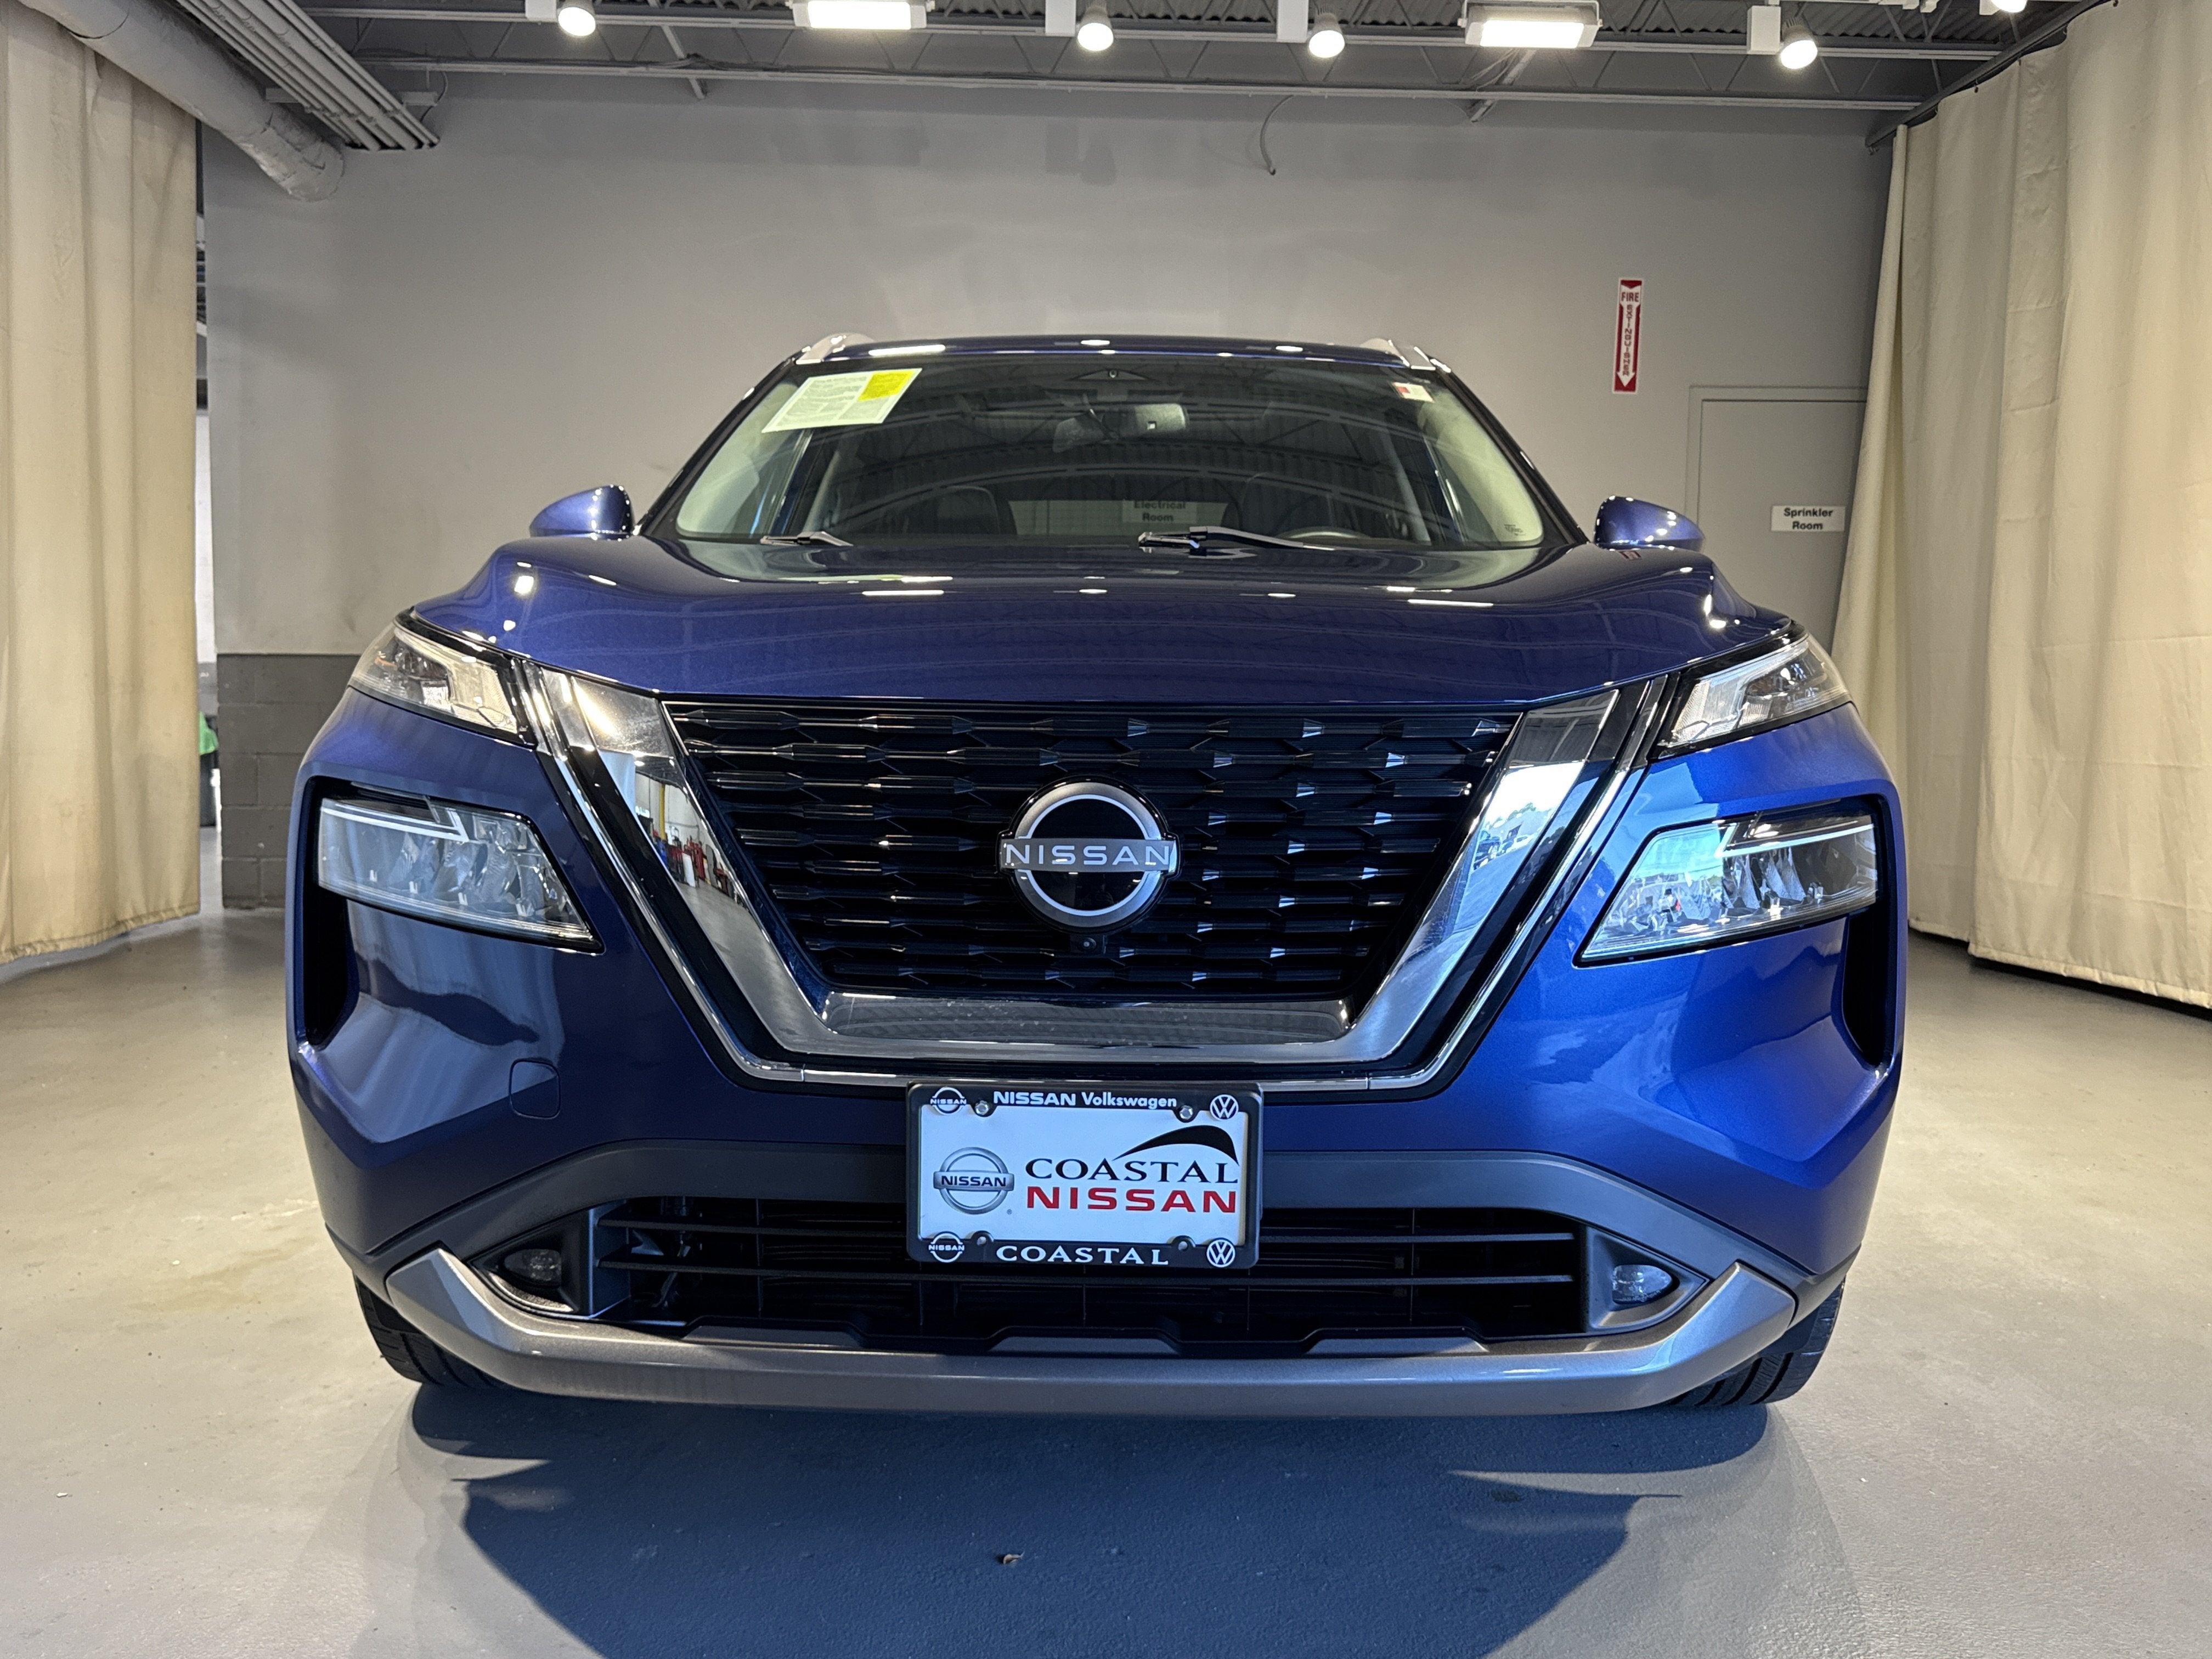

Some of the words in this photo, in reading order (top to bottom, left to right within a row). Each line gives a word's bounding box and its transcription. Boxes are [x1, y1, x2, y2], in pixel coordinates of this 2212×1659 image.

[1621, 292, 1639, 302] FIRE
[1622, 304, 1633, 376] EXTINGUISHER
[1142, 512, 1175, 522] Room
[1784, 507, 1833, 518] Sprinkler
[1792, 521, 1823, 530] Room
[1006, 844, 1169, 866] NISSAN
[994, 1091, 1076, 1105] NISSAN
[1081, 1092, 1177, 1109] Volkswagen
[1025, 1158, 1238, 1184] COASTAL
[941, 1175, 1007, 1187] NISSAN
[1026, 1186, 1236, 1213] NISSAN
[996, 1245, 1169, 1265] COASTAL
